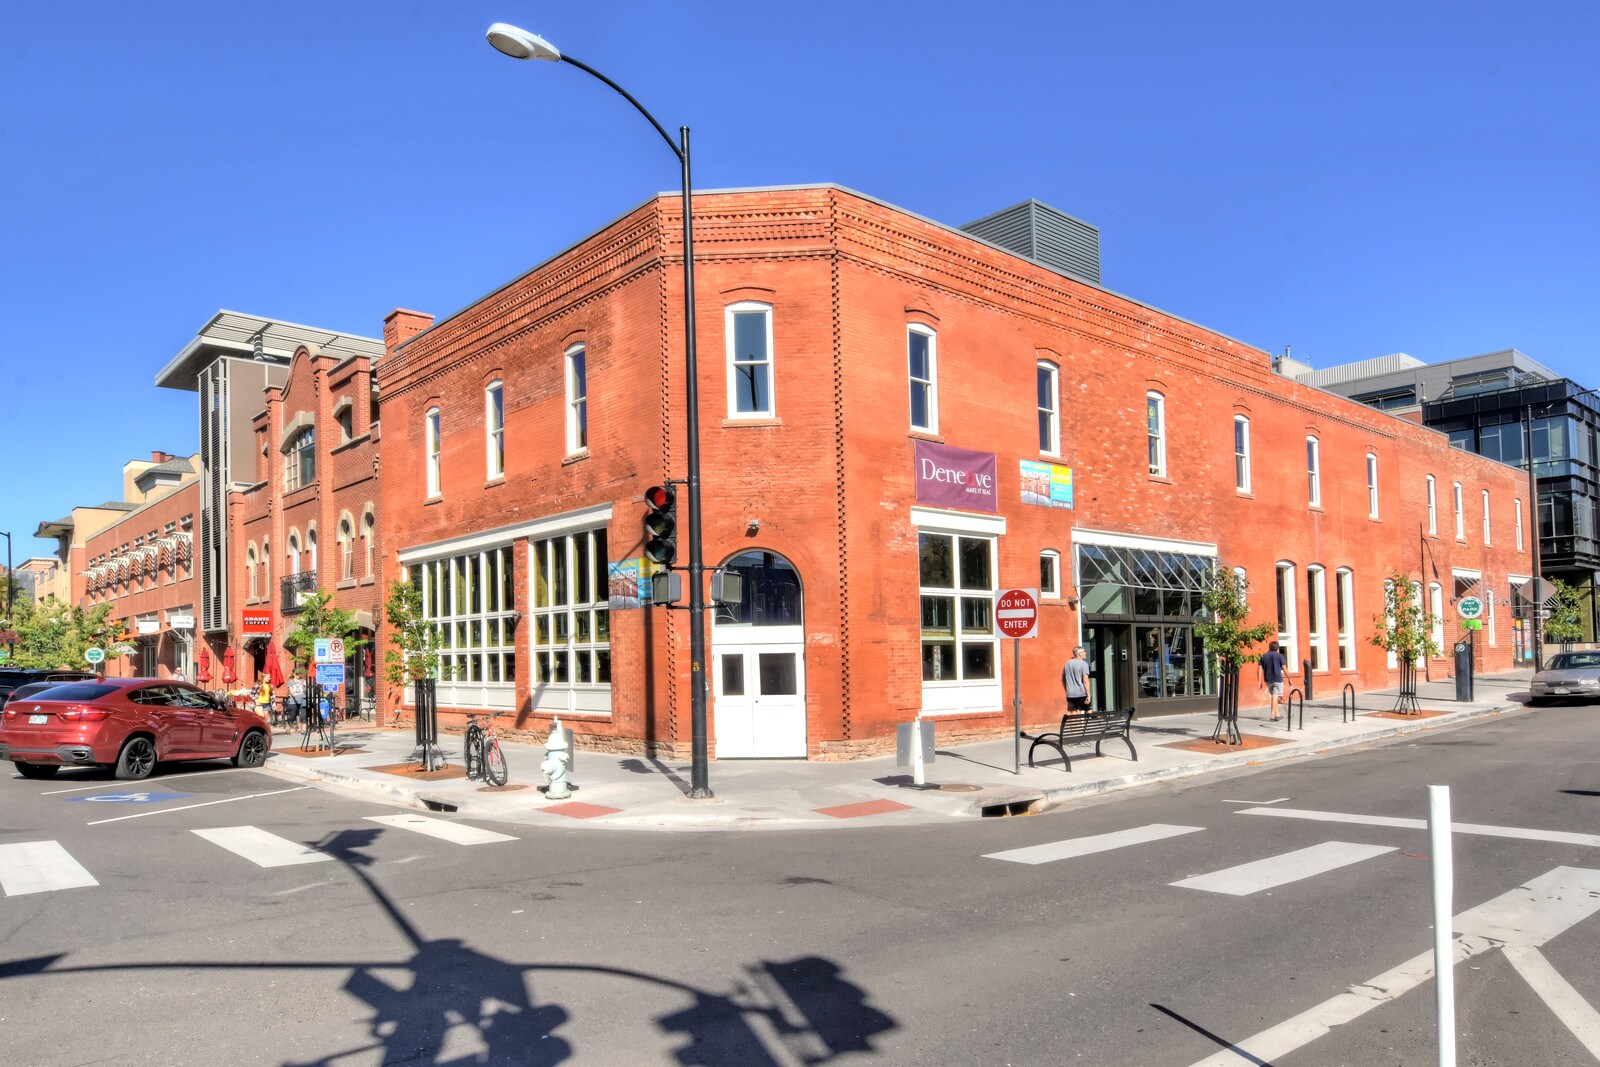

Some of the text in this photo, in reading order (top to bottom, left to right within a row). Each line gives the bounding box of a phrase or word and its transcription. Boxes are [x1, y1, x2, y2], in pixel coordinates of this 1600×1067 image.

[921, 458, 992, 488] Deneuve
[1001, 598, 1031, 608] DO NOT
[1003, 620, 1028, 629] ENTER
